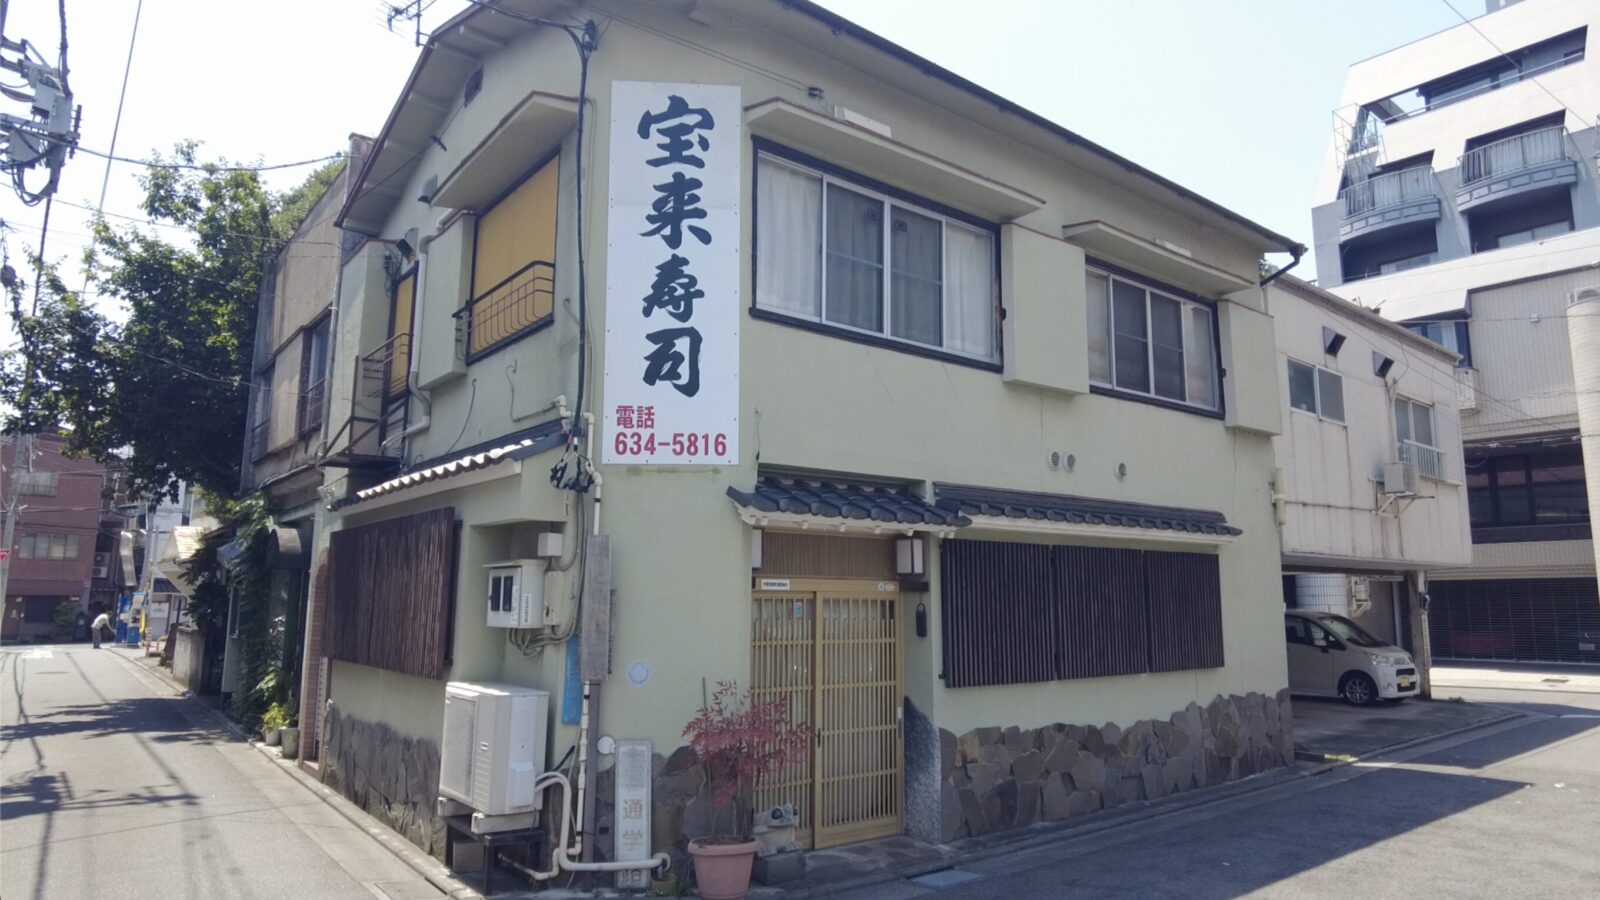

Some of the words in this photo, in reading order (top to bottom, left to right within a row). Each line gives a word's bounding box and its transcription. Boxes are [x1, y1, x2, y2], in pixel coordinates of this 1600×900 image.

[637, 94, 715, 398] 宝来寿司
[615, 405, 655, 429] 電話
[614, 432, 727, 456] 634-5816
